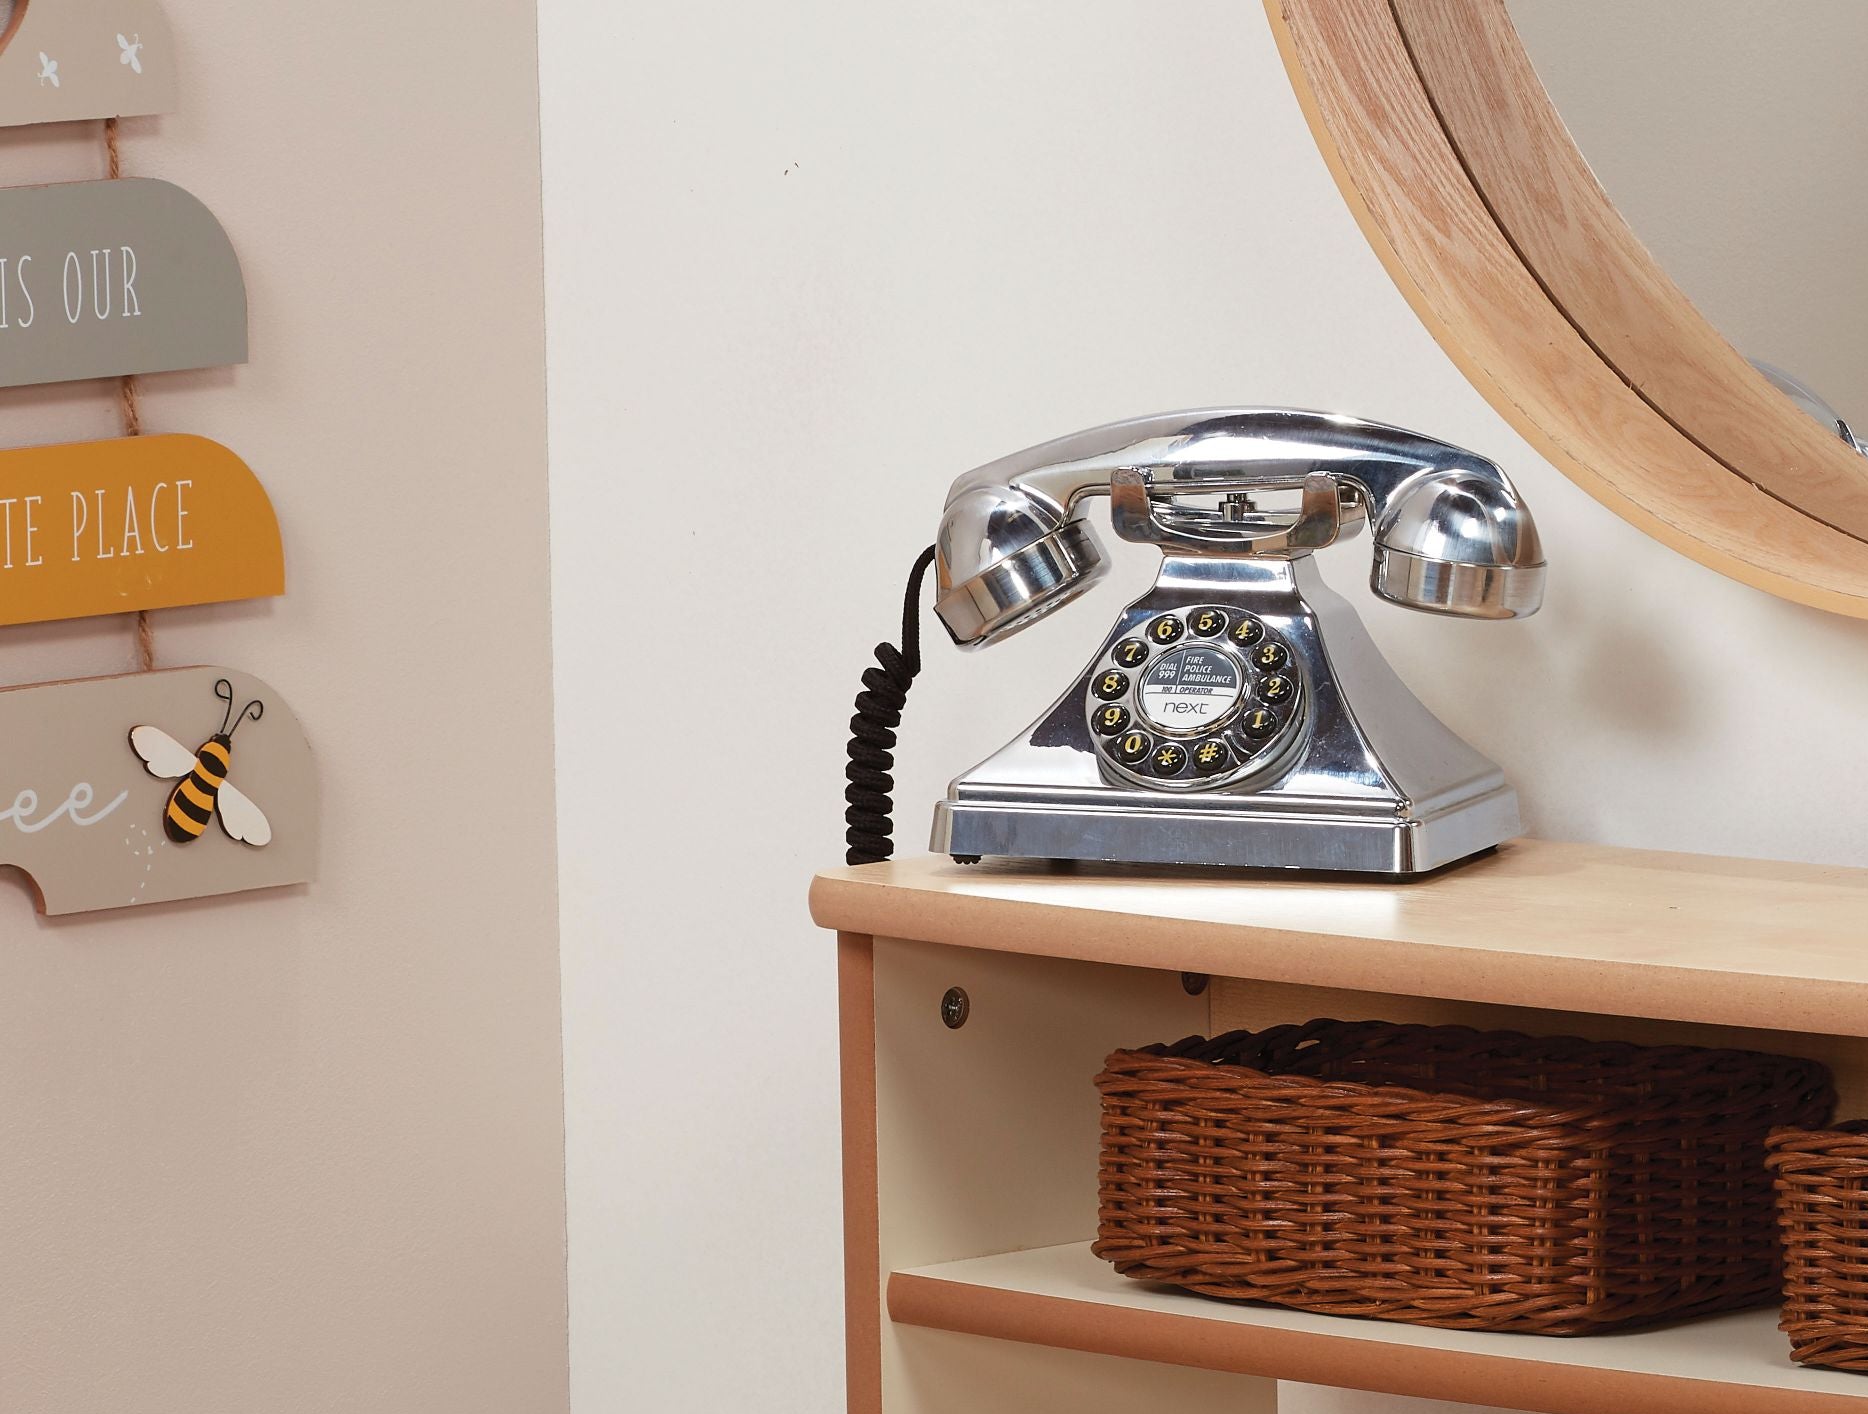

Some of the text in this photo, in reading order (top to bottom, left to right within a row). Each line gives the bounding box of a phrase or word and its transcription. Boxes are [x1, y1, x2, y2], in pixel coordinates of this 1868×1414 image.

[63, 246, 142, 324] OUR
[71, 479, 194, 563] PLACE
[1157, 621, 1172, 638] 6
[1199, 615, 1212, 630] 5
[1235, 623, 1249, 638] 4
[1125, 645, 1137, 661] 7
[1186, 656, 1204, 664] FIRE
[1262, 647, 1275, 664] 3
[1159, 671, 1176, 679] 999
[1160, 663, 1177, 671] DIAL
[1184, 665, 1212, 673] POLICE
[1103, 675, 1118, 692] 8
[1182, 674, 1232, 684] AMBULANCE
[1269, 678, 1281, 694] 2
[1163, 702, 1209, 714] next
[1104, 709, 1120, 726] 9
[1253, 712, 1263, 728] 1
[1125, 735, 1141, 752] 0
